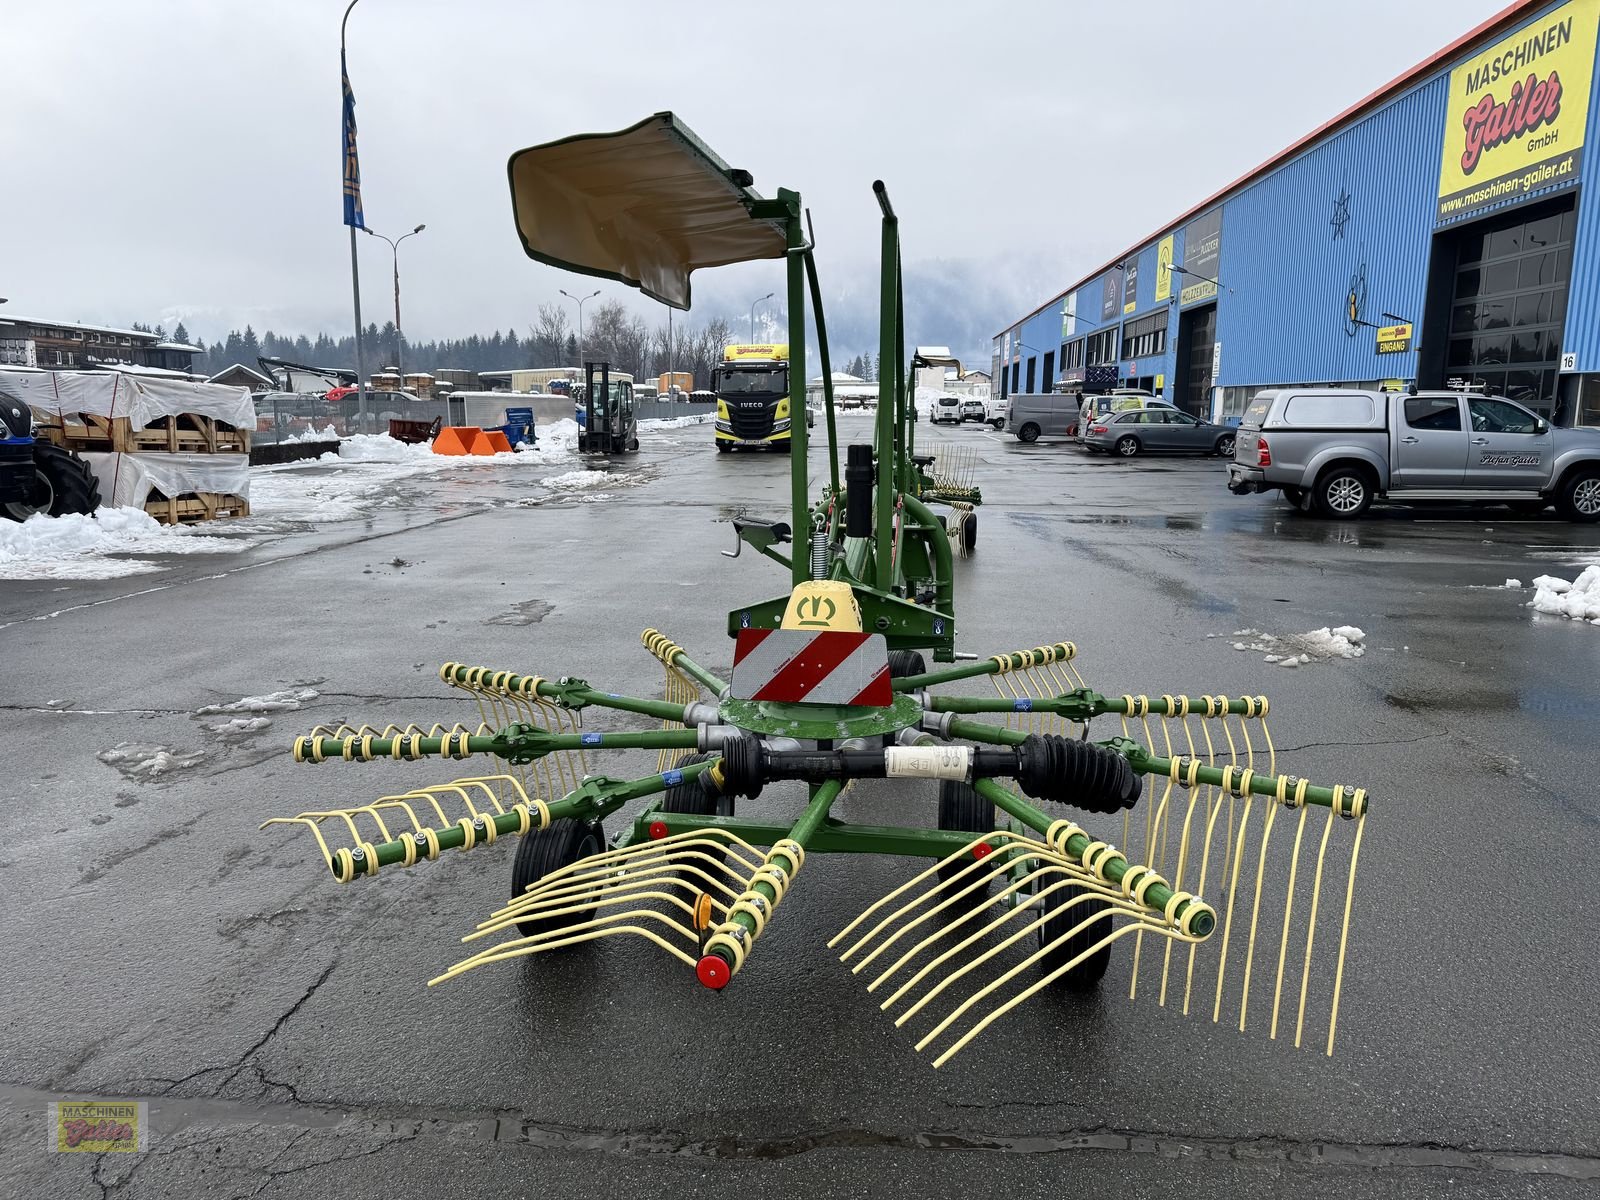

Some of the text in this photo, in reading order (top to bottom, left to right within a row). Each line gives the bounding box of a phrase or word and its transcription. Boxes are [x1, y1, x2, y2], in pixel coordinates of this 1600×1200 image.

[1465, 16, 1572, 96] MASCHINEN
[1461, 70, 1563, 176] Gailer
[1527, 129, 1559, 153] GmbH
[1440, 156, 1573, 214] www.maschinen-gailer.at
[1379, 340, 1405, 353] EINGANG
[1563, 356, 1574, 368] 16
[1480, 455, 1541, 467] Stefan Gailer
